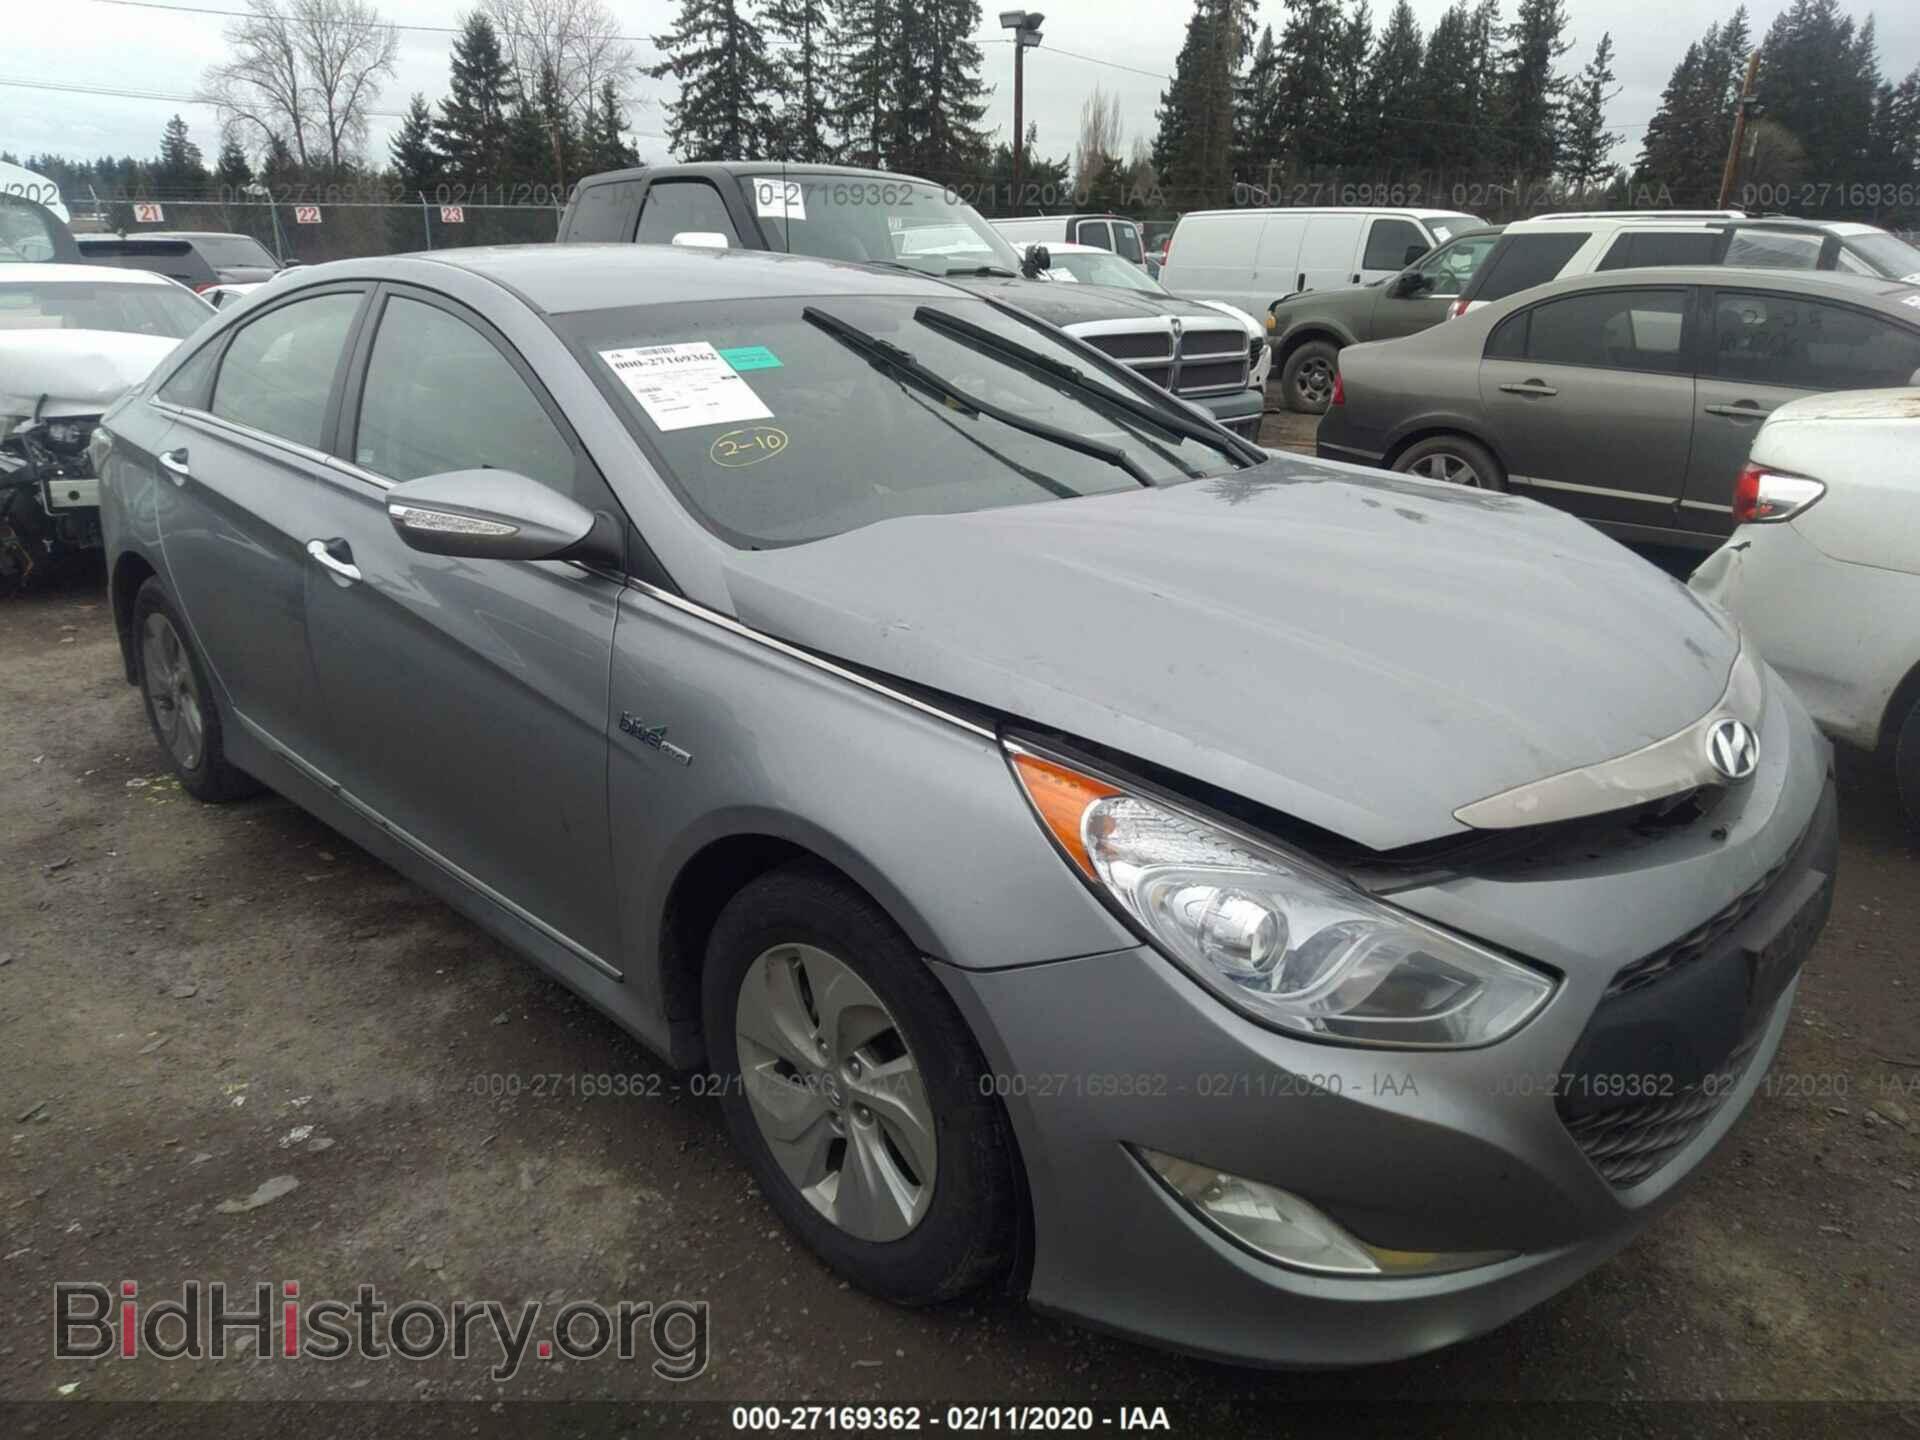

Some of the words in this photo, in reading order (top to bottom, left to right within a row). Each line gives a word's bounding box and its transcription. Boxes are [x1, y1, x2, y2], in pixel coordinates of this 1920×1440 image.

[139, 206, 159, 222] 21
[299, 207, 319, 222] 22
[442, 207, 461, 222] 23
